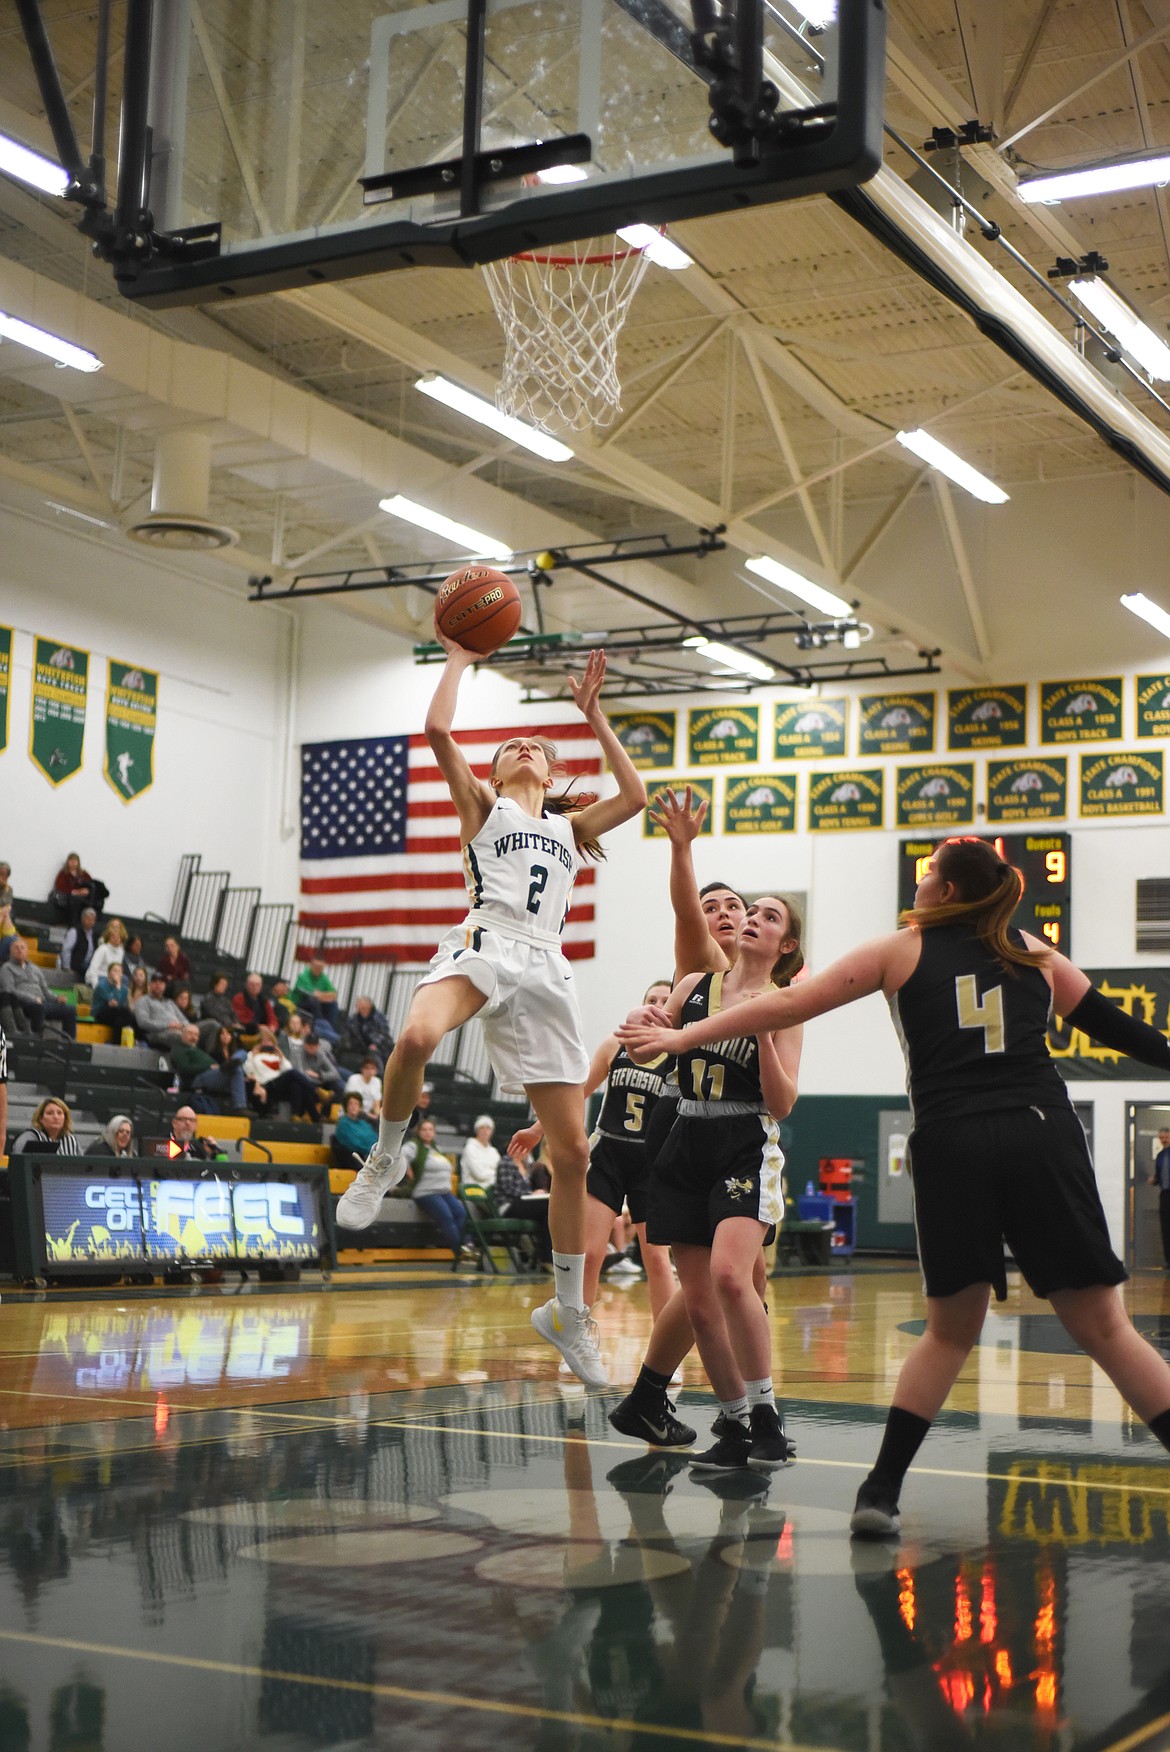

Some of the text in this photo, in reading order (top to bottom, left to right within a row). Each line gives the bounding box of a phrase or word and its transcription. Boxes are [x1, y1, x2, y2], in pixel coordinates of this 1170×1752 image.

[448, 588, 503, 627] ELITE PRO
[1139, 680, 1163, 705] STATE
[1048, 716, 1074, 728] CLASS
[990, 760, 1065, 788] STATE CHAMPIONS
[1083, 755, 1161, 783] STATE CHAMPIONS
[994, 794, 1020, 805] CLASS
[1020, 794, 1028, 804] A
[1087, 789, 1114, 799] CLASS
[1115, 789, 1123, 798] A
[1083, 801, 1161, 813] BOYS BASKETBALL
[905, 843, 933, 856] Home
[1026, 837, 1062, 851] Guests
[1045, 850, 1066, 883] 9
[526, 864, 548, 915] 2
[1034, 904, 1062, 918] Fouls
[1043, 922, 1060, 945] 4
[955, 974, 1005, 1054] 4
[690, 1058, 725, 1100] 11
[624, 1092, 646, 1132] 5
[85, 1186, 147, 1208] GET
